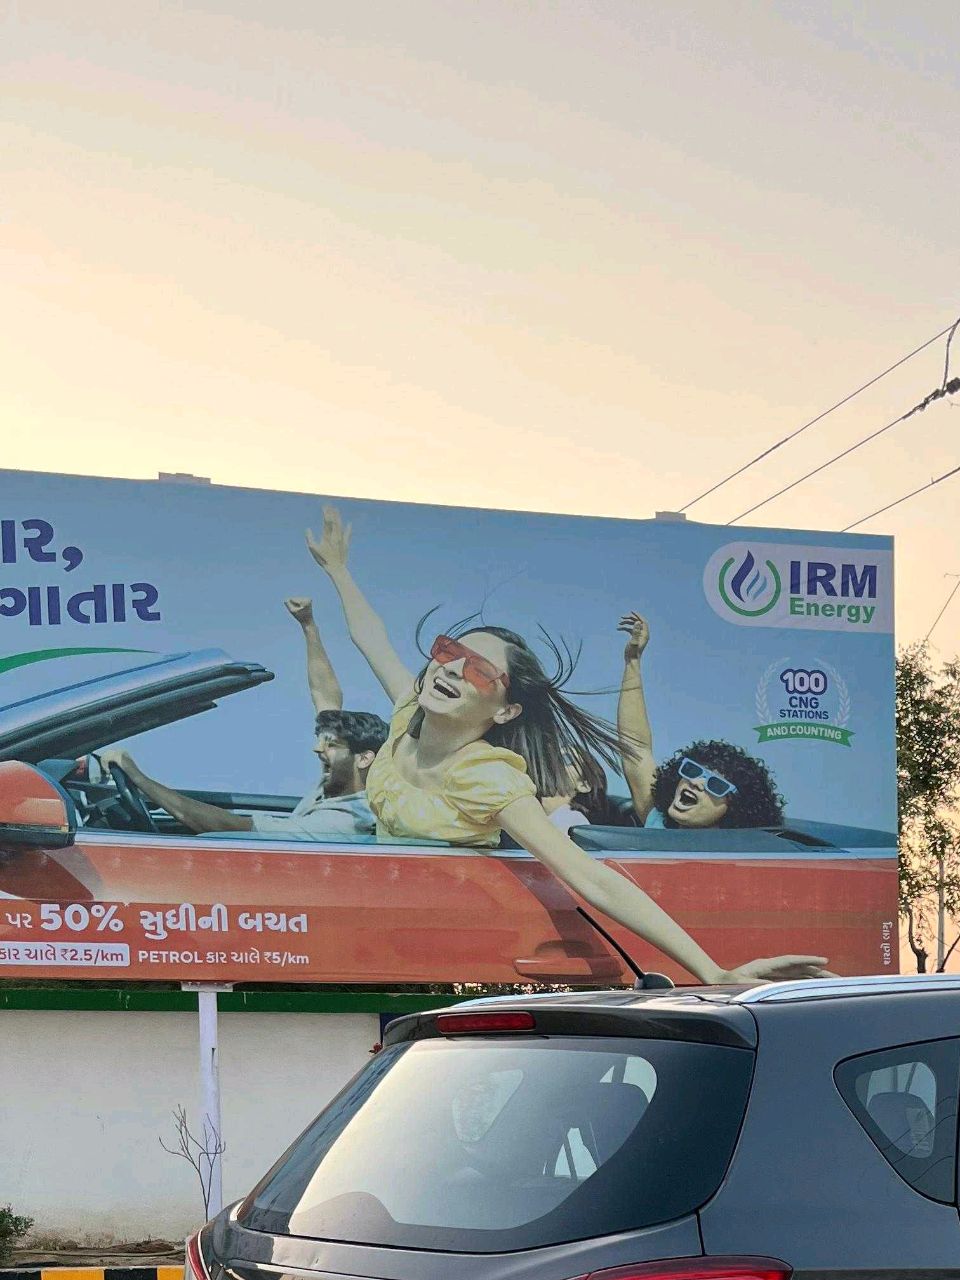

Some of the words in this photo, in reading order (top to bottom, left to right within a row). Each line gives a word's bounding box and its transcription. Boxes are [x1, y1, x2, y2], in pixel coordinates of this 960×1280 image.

[790, 560, 878, 599] IRM
[789, 597, 877, 624] Energy
[780, 668, 828, 696] 100
[788, 696, 819, 709] CNG
[779, 709, 829, 720] STATIONS
[766, 725, 788, 737] AND
[790, 725, 842, 741] COUNTING
[5, 911, 33, 930] પર
[40, 902, 125, 932] 50%
[139, 902, 229, 940] સુધીની
[238, 911, 309, 933] બચત
[25, 944, 56, 961] ચાલે
[61, 947, 124, 965] ₹2.5/km
[138, 950, 203, 964] PETROL
[206, 951, 227, 964] કાર
[231, 947, 260, 964] ચાલે
[264, 951, 310, 967] ₹5/km
